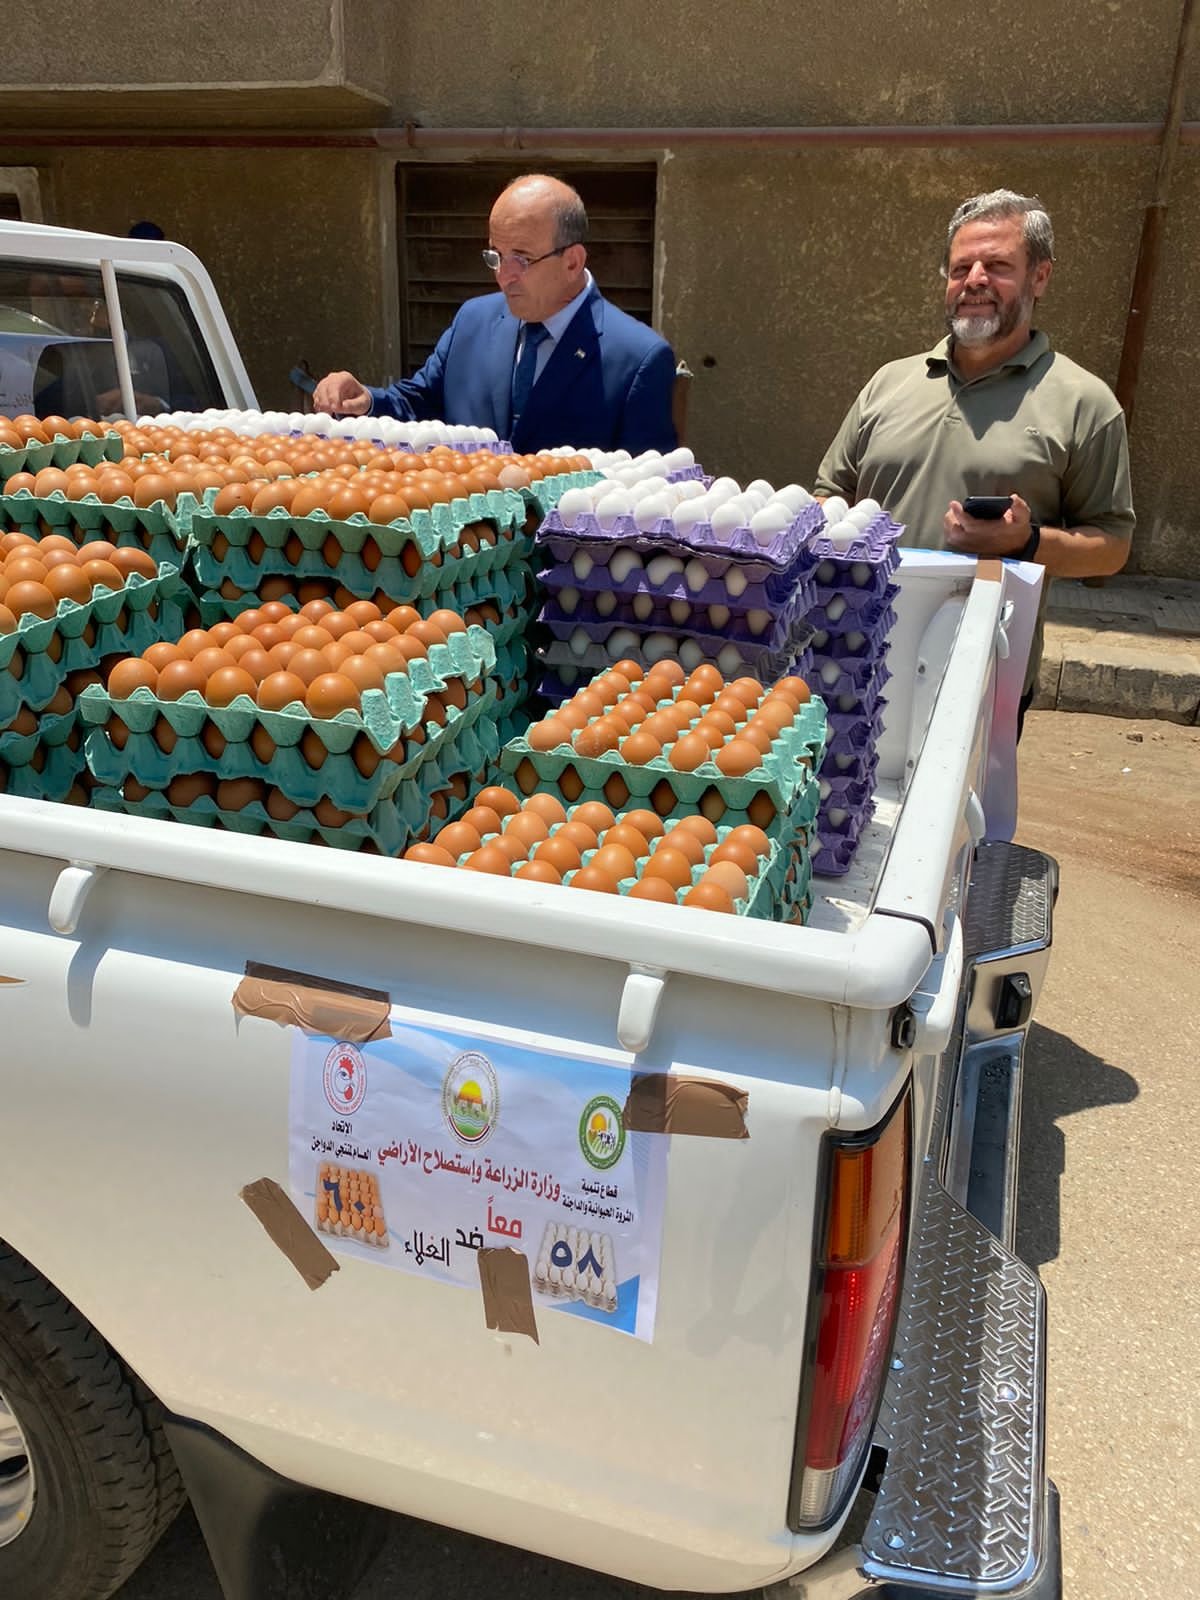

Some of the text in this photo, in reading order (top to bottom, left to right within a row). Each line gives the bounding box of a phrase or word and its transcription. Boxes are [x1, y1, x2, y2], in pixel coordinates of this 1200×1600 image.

[311, 1136, 335, 1152] الدواجن
[377, 1139, 561, 1201] وزارة الزراعة وإستصلاح الأراضي
[581, 1178, 618, 1199] قطاع تنمية
[487, 1195, 522, 1238] معاً
[588, 1200, 615, 1219] الحيوانية
[615, 1207, 634, 1223] الثروة
[404, 1226, 484, 1266] ضد الغلاء
[551, 1240, 603, 1279] ٥٨
